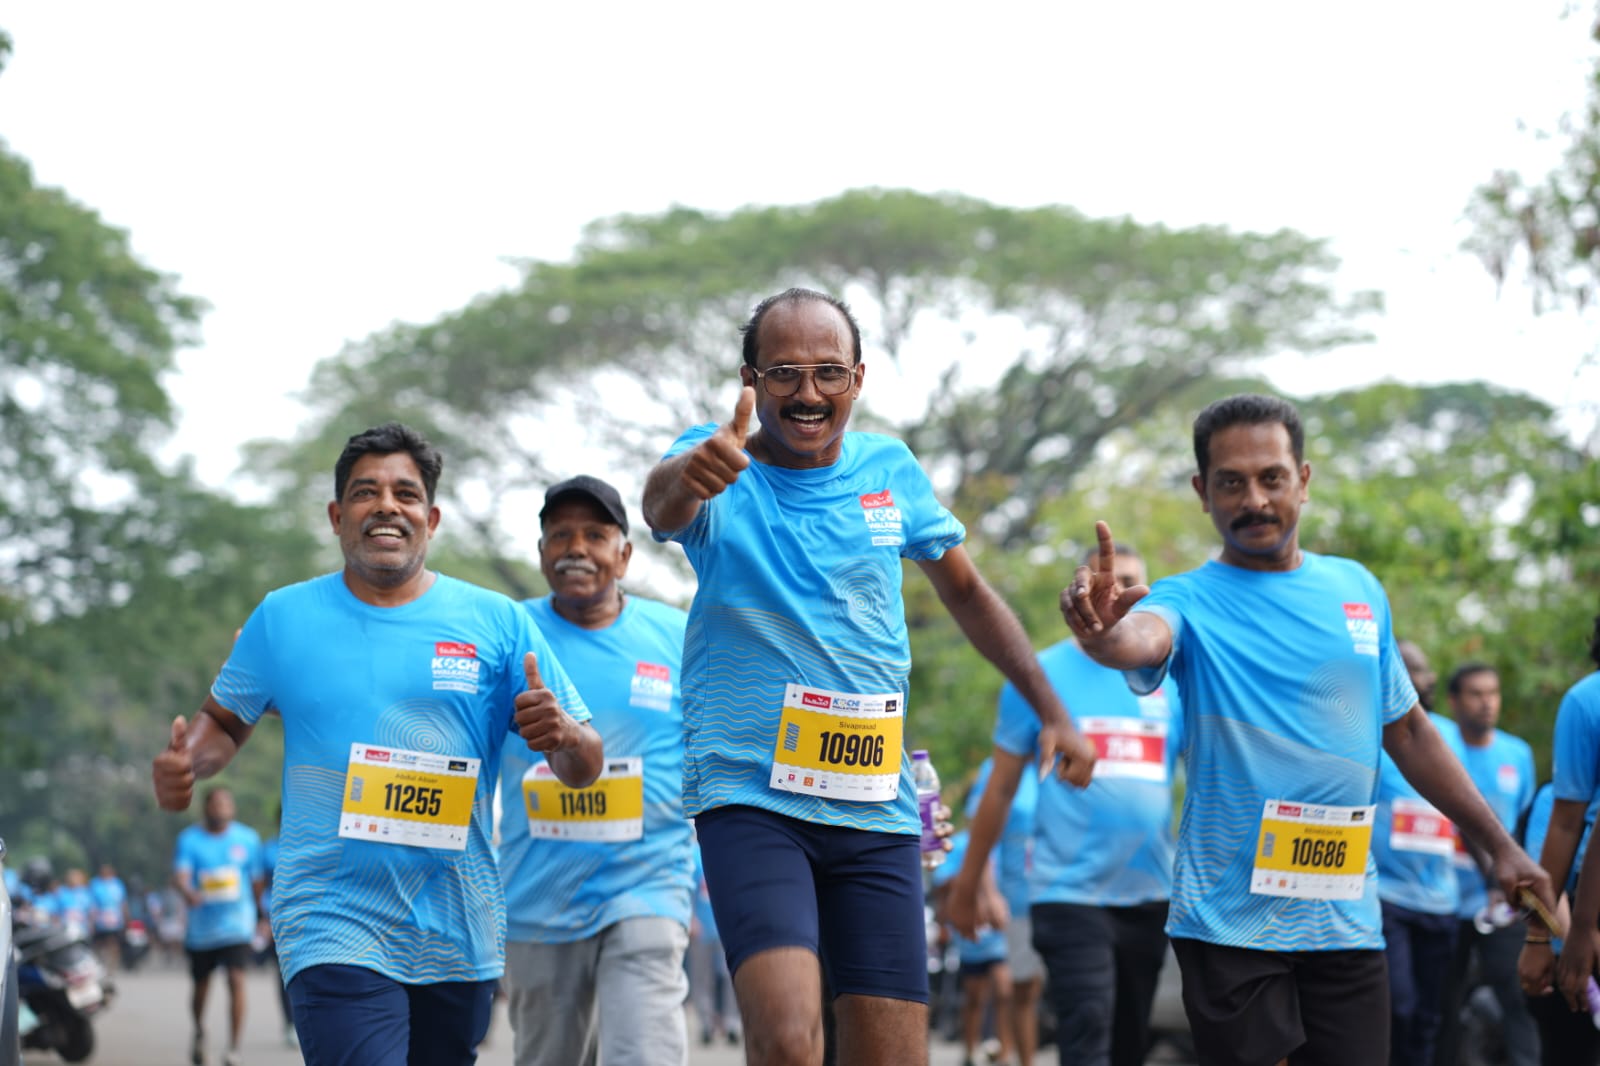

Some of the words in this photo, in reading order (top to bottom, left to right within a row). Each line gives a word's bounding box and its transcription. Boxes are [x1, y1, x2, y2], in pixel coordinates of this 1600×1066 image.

[839, 721, 877, 731] Sivaprasad
[818, 731, 885, 767] 10906
[384, 783, 443, 817] 11255
[559, 790, 607, 817] 11419
[1291, 837, 1348, 869] 10686
